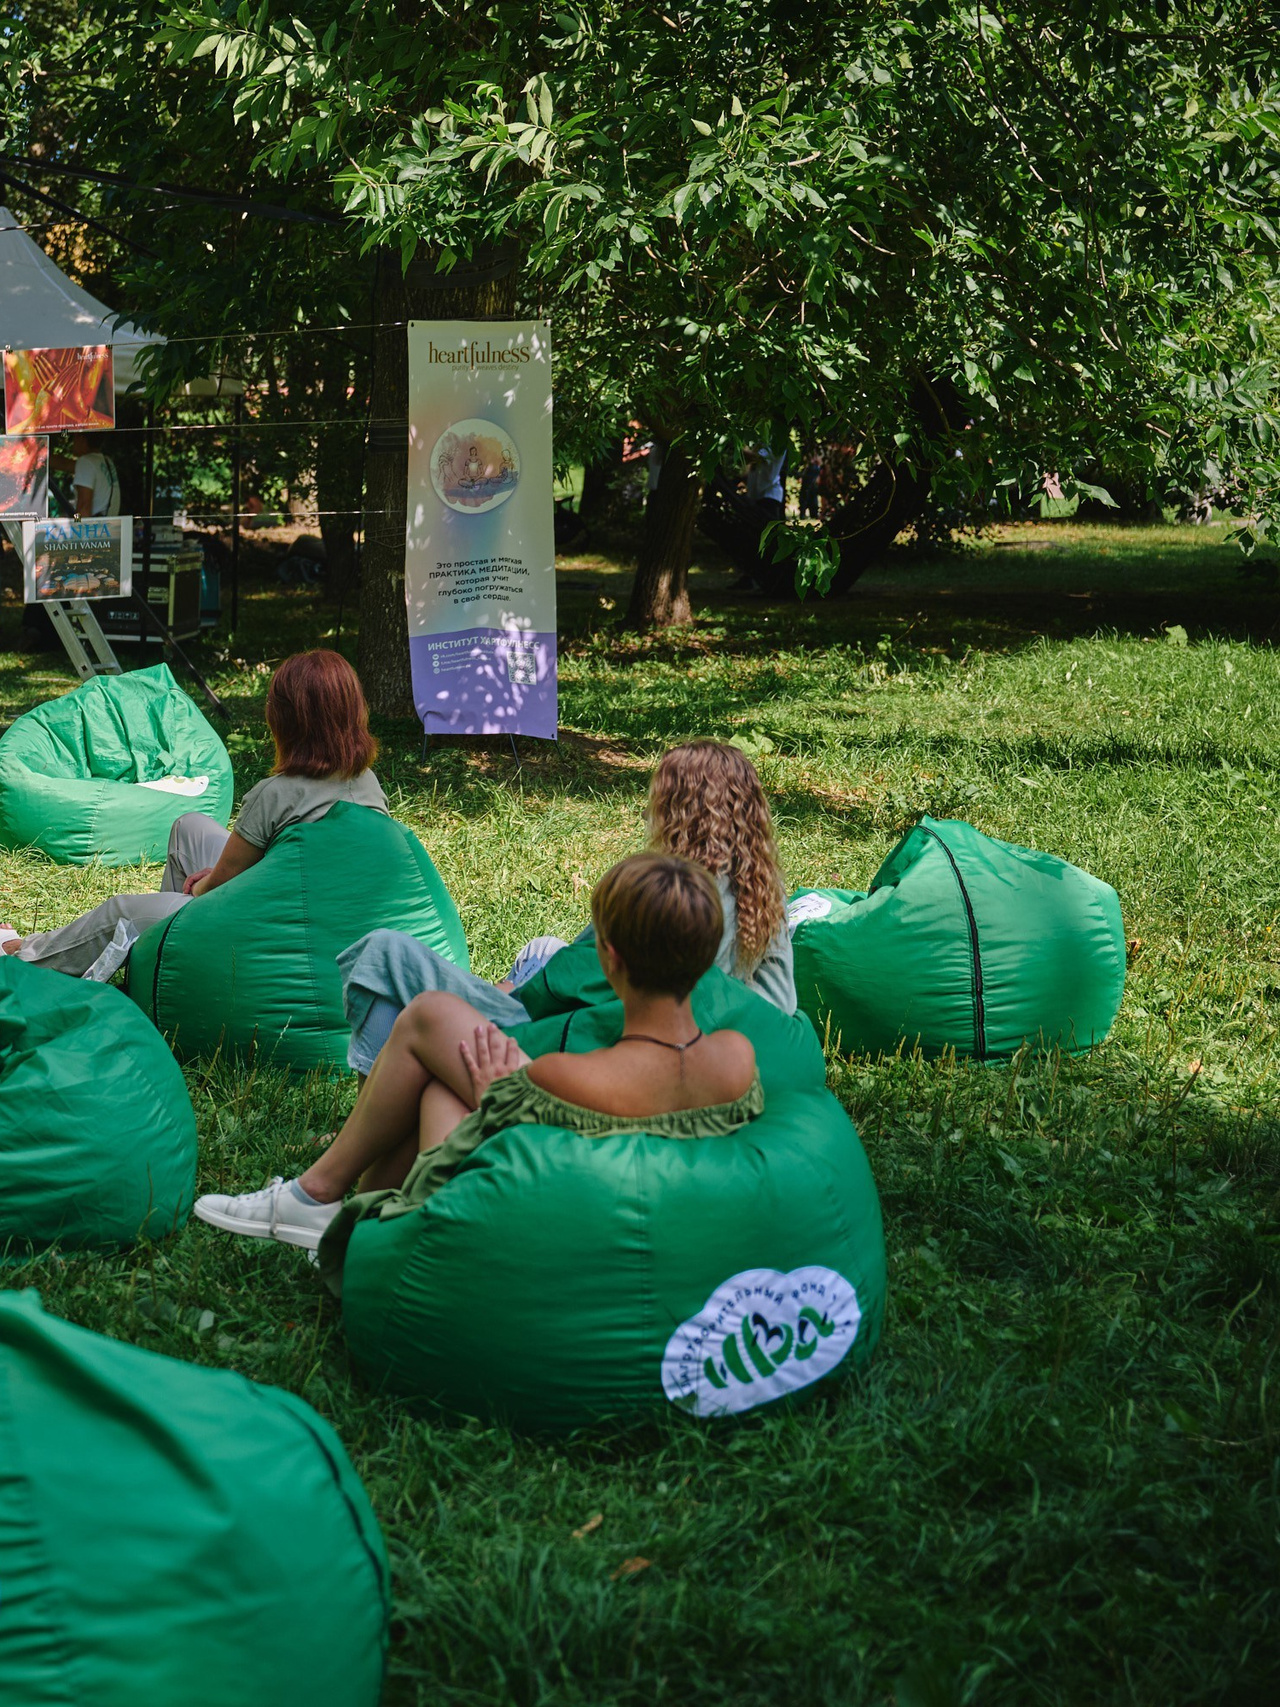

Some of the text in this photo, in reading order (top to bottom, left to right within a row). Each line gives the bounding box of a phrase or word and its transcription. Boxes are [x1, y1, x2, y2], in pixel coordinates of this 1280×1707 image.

[77, 352, 109, 361] heartfulness
[428, 341, 530, 371] heartfulness
[45, 523, 111, 541] KANHA
[44, 541, 111, 551] SHANTI VANAM
[454, 558, 488, 568] простая
[498, 556, 522, 565] мягкая
[429, 565, 529, 579] ПРАКТИКА МЕДИТАЦИИ,
[455, 576, 490, 586] которая
[438, 584, 523, 597] глубоко погружаться
[460, 594, 481, 603] своё
[482, 593, 511, 602] сердце.
[427, 636, 541, 651] ИНСТИТУТ ХАРТФУЛНЕСС
